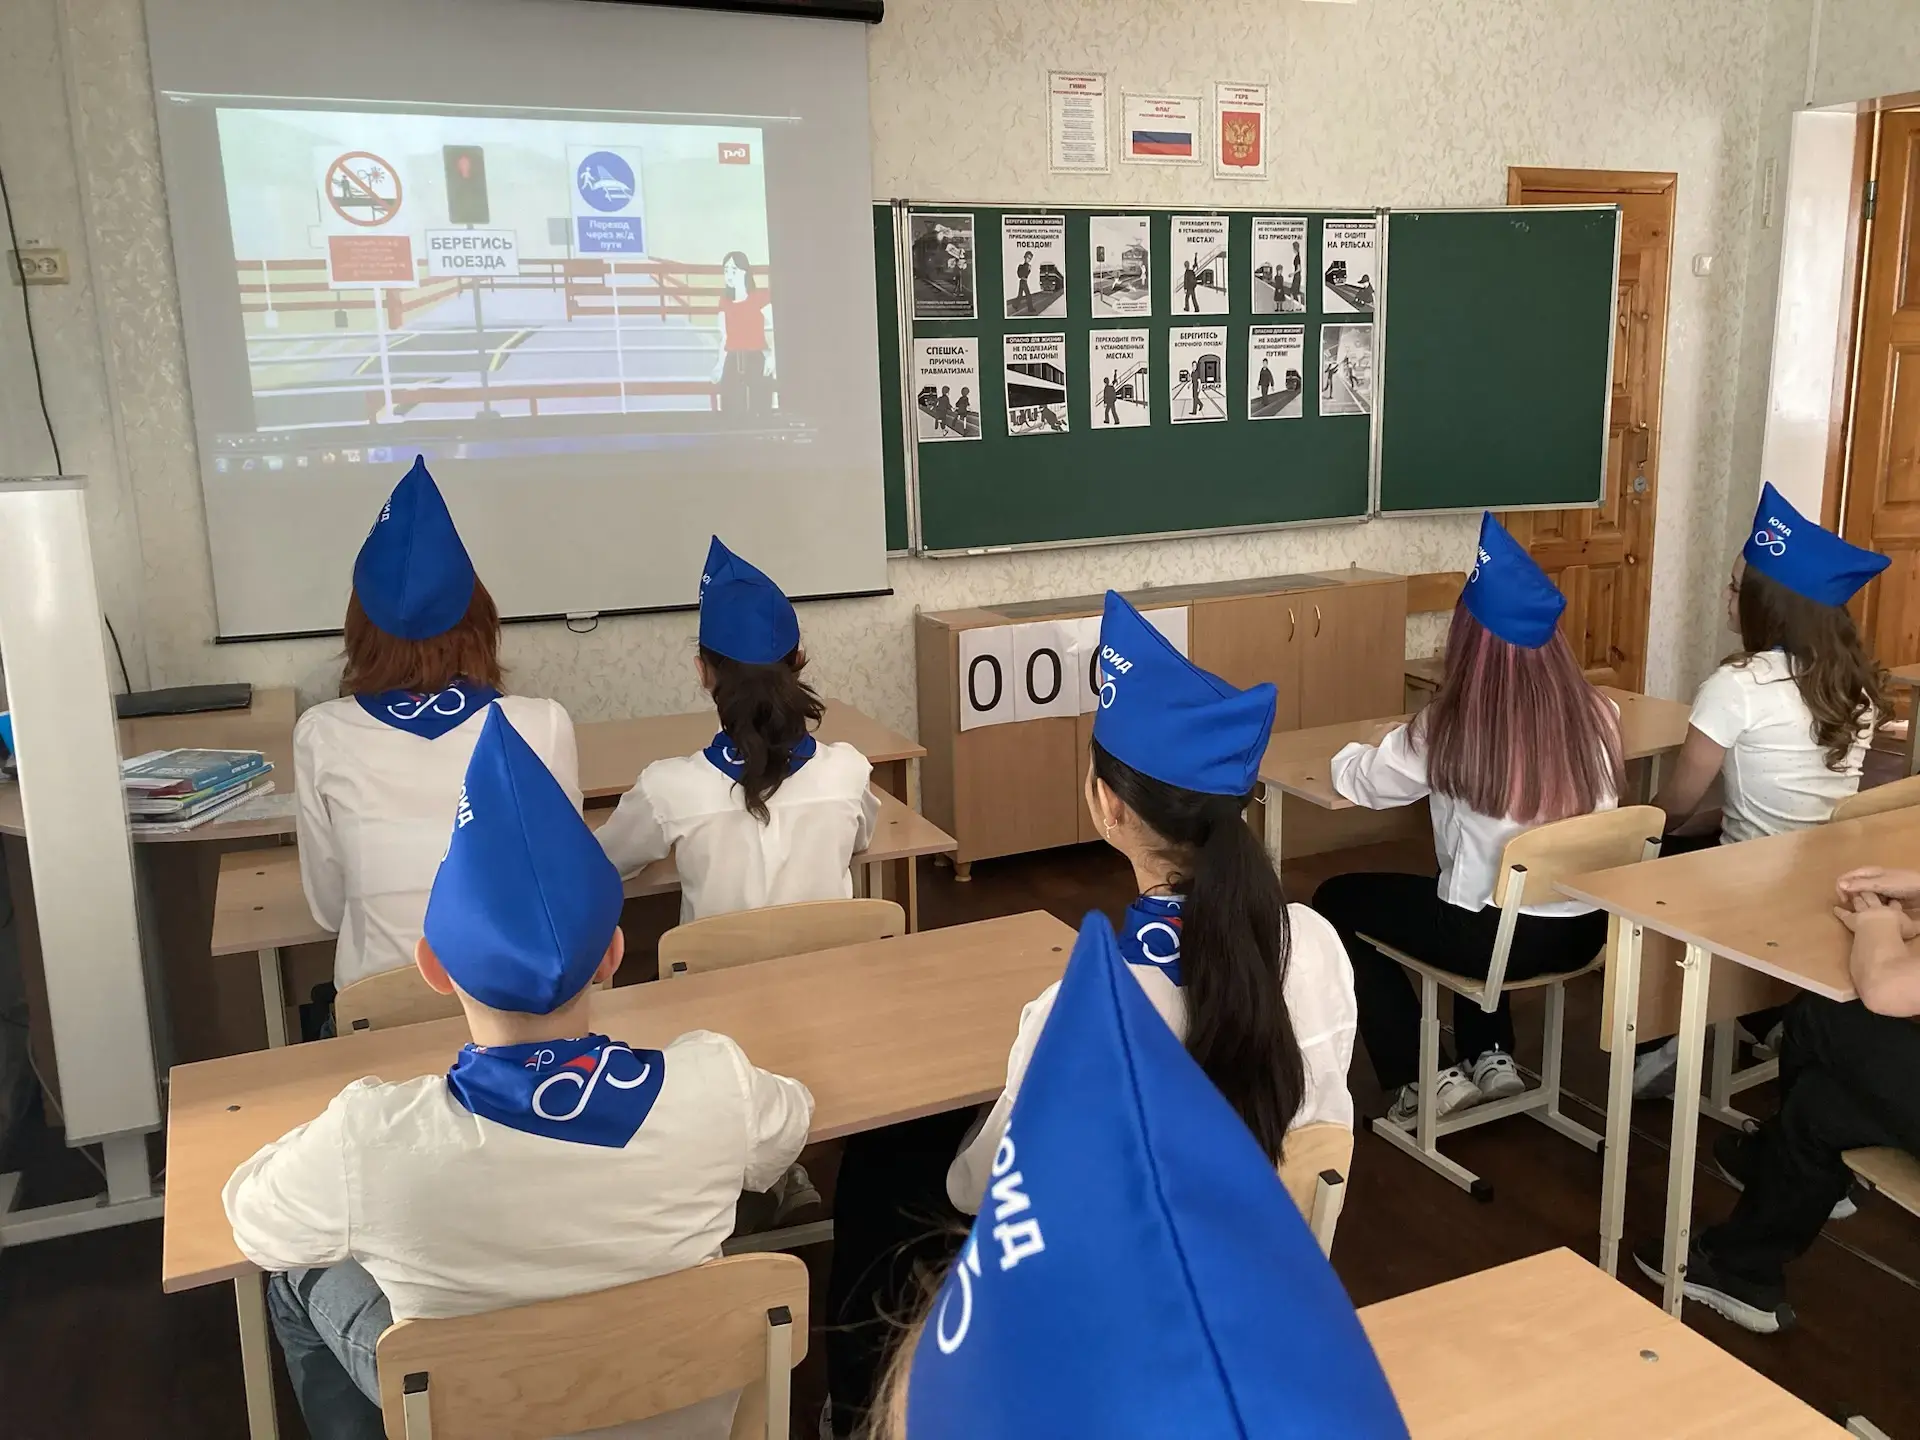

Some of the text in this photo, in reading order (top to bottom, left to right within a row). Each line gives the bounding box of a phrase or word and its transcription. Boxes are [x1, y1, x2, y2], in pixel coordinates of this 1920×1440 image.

[589, 219, 630, 231] Переход
[586, 230, 635, 241] через ж/д
[431, 237, 513, 250] БЕРЕГИСЬ
[600, 241, 622, 250] пути
[442, 255, 506, 270] ПОЕЗДА
[1022, 344, 1058, 352] ПОДЛЕЗАЙТЕ
[921, 367, 975, 375] ТРАВМАТИЗМА!
[1768, 516, 1792, 537] ЮИД
[1101, 644, 1134, 674] ЮИД
